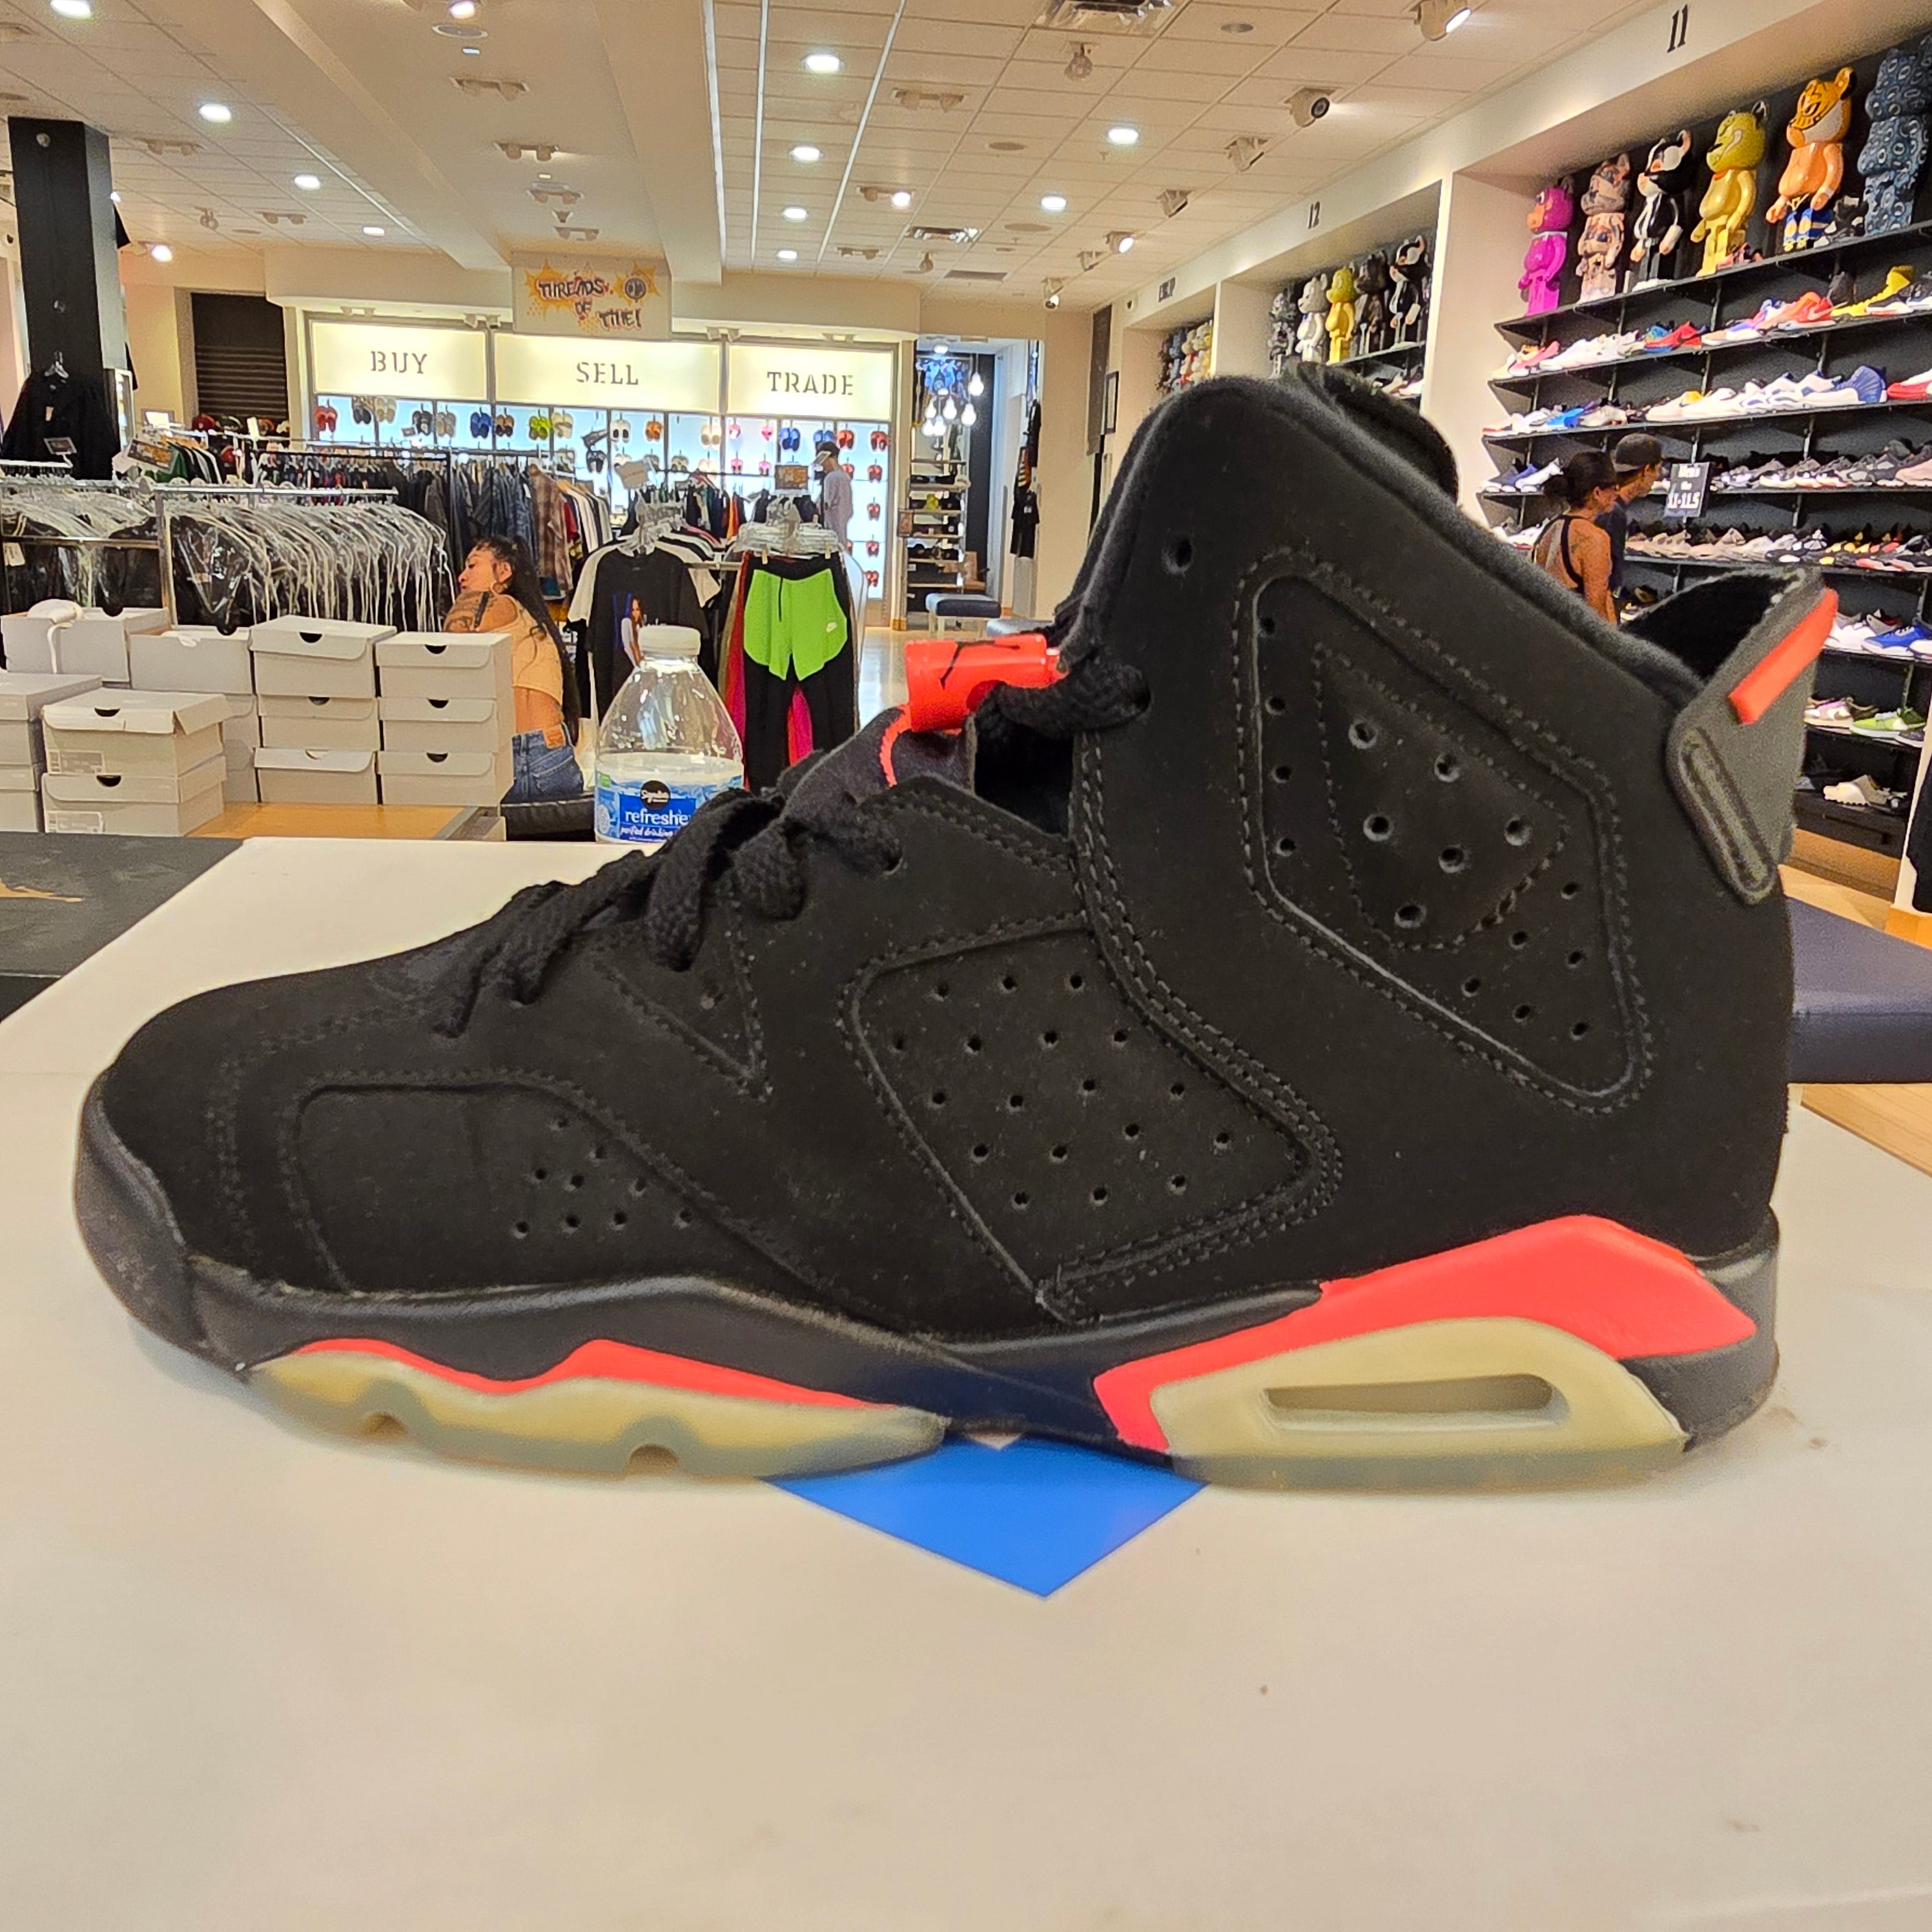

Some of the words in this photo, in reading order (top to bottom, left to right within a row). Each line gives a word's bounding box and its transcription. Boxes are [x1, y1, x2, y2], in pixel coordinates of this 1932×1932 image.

[371, 351, 427, 375] BUY
[576, 362, 639, 385] SELL
[767, 371, 854, 395] TRADE
